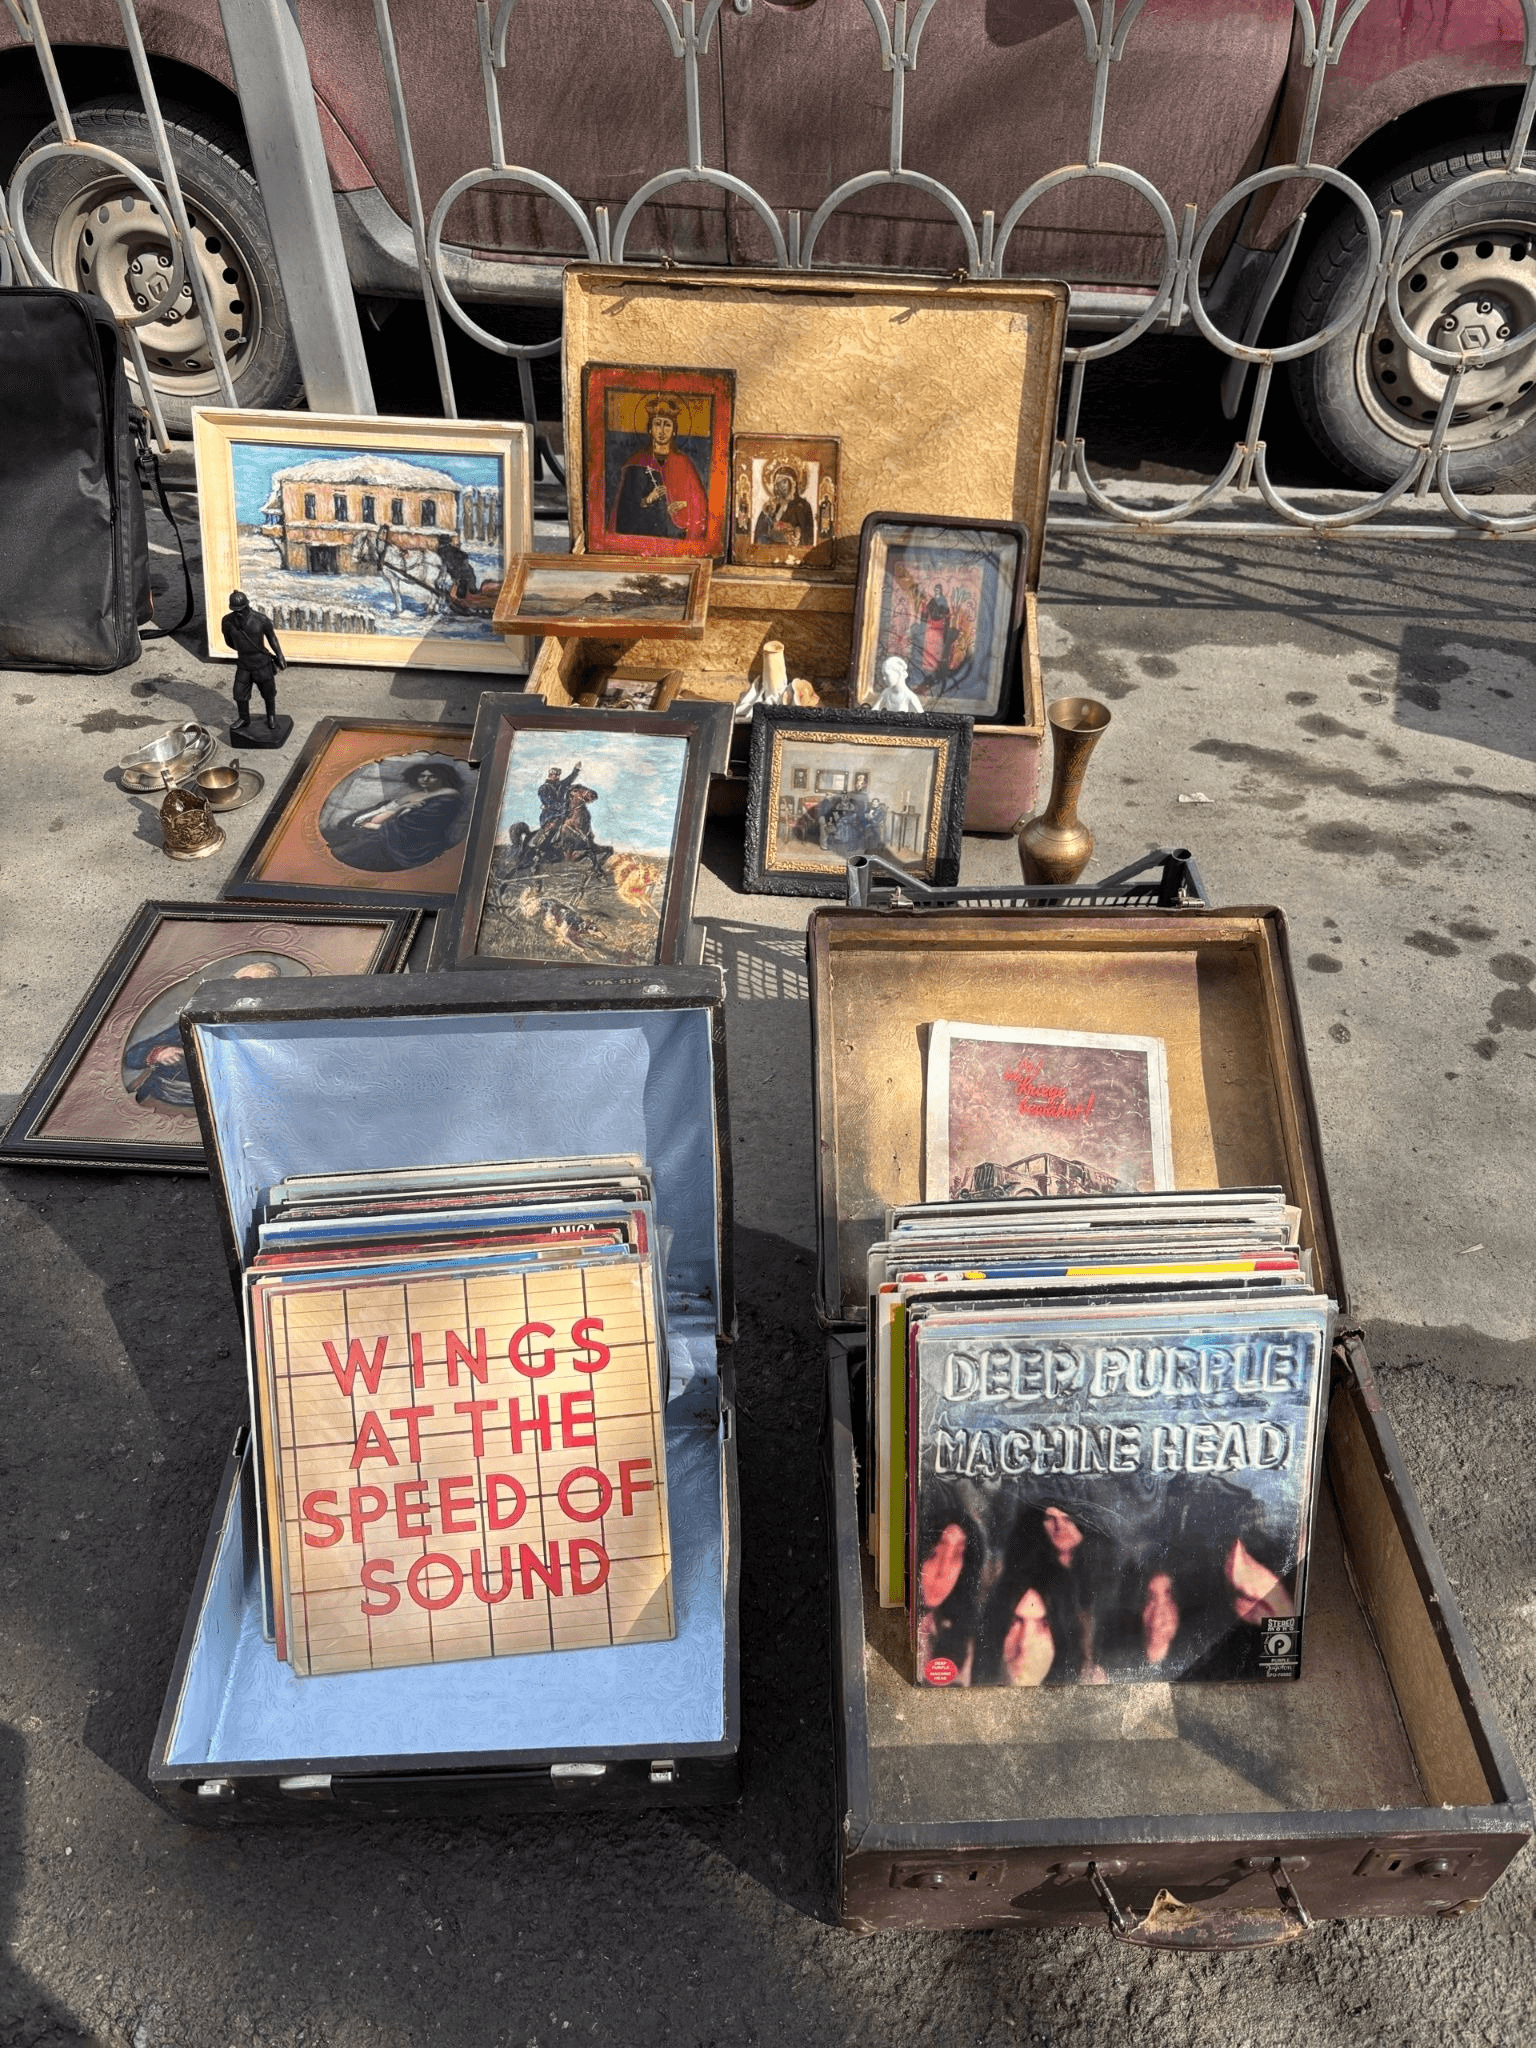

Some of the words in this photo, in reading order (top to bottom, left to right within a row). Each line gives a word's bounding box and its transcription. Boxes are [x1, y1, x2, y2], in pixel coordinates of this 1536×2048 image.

[322, 1317, 611, 1396] WINGS
[945, 1346, 1084, 1401] DEEP
[1089, 1343, 1299, 1398] PURPLE
[349, 1405, 434, 1469] AT
[454, 1390, 597, 1457] THE
[936, 1423, 1141, 1477] MACHINE
[1150, 1421, 1294, 1474] HEAD
[302, 1473, 527, 1548] SPEED
[557, 1458, 654, 1523] OF
[360, 1538, 610, 1616] SOUND
[1267, 1618, 1295, 1627] STEREO
